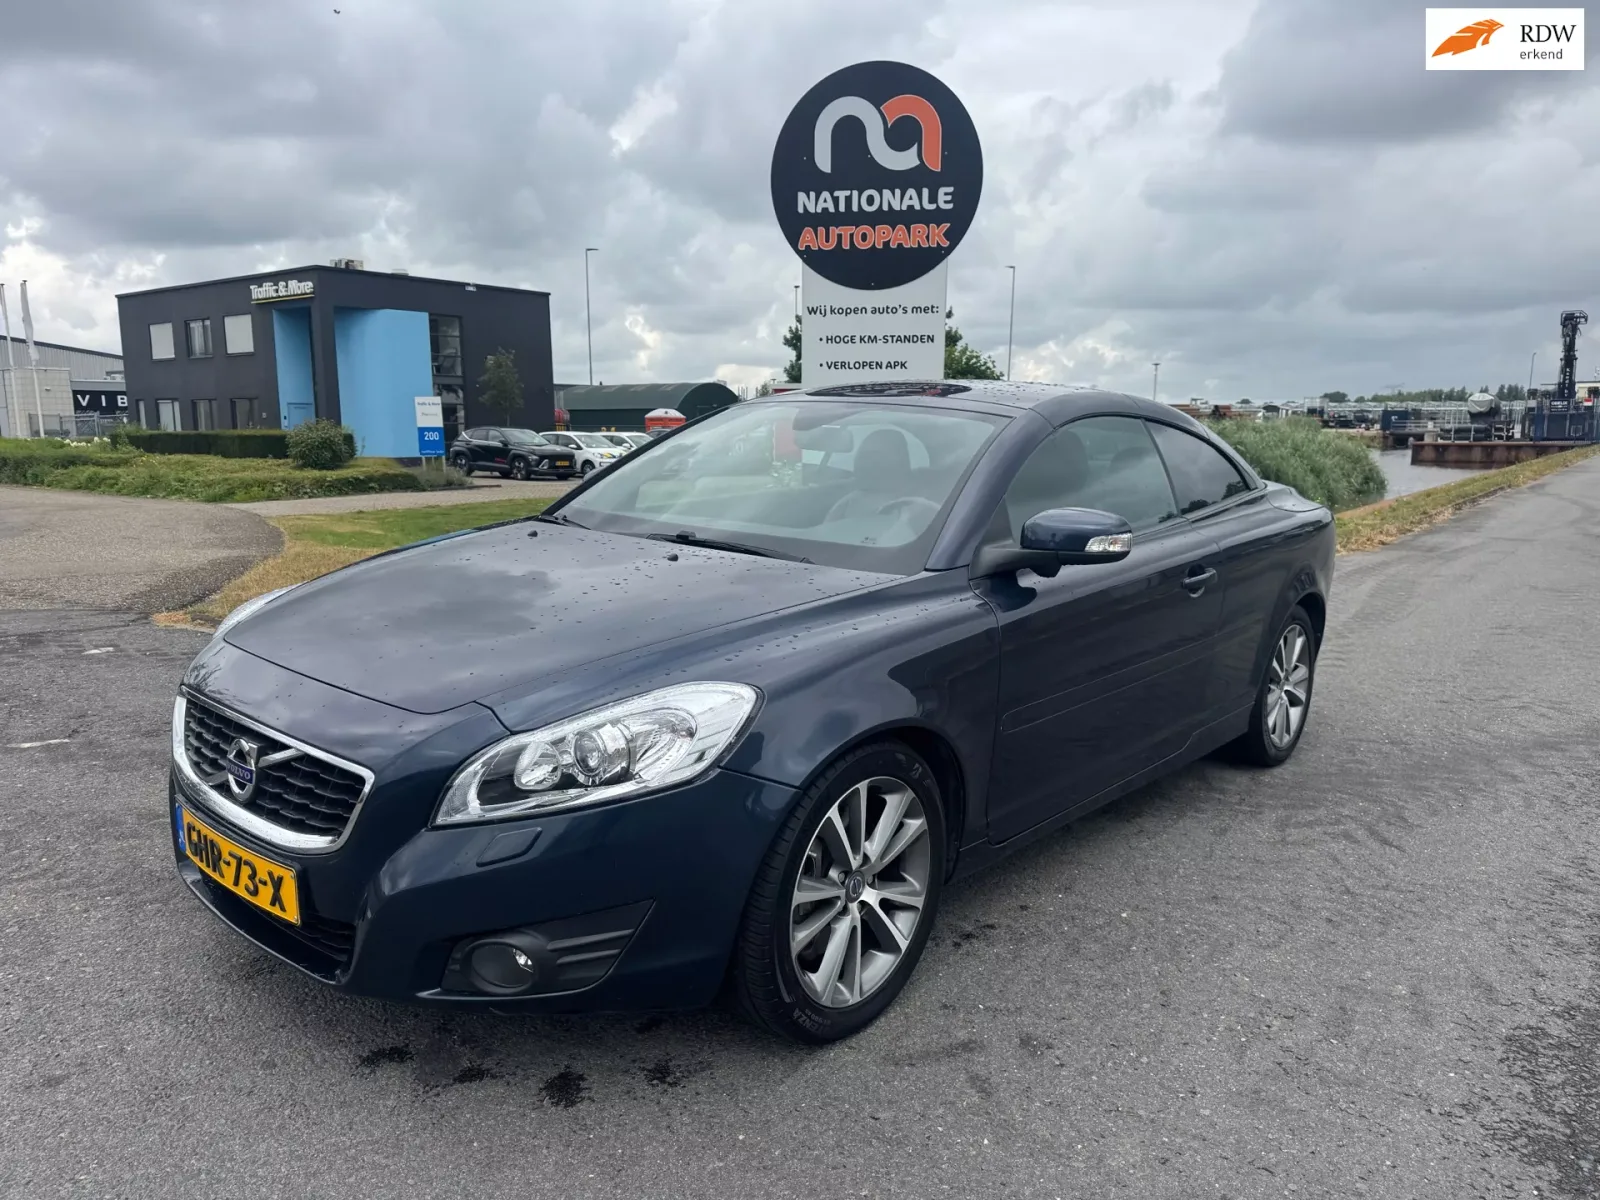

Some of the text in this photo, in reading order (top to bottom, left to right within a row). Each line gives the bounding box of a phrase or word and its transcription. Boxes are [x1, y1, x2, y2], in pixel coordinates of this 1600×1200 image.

[797, 186, 954, 214] NATIONALE
[798, 223, 950, 250] AUTOPARK
[250, 282, 278, 299] Traffic
[288, 280, 314, 295] More
[806, 303, 939, 317] Wij kopen auto's met:
[826, 334, 935, 344] HOGE KM-STANDEN
[826, 361, 908, 370] VERLOPEN APK
[424, 432, 440, 441] 200
